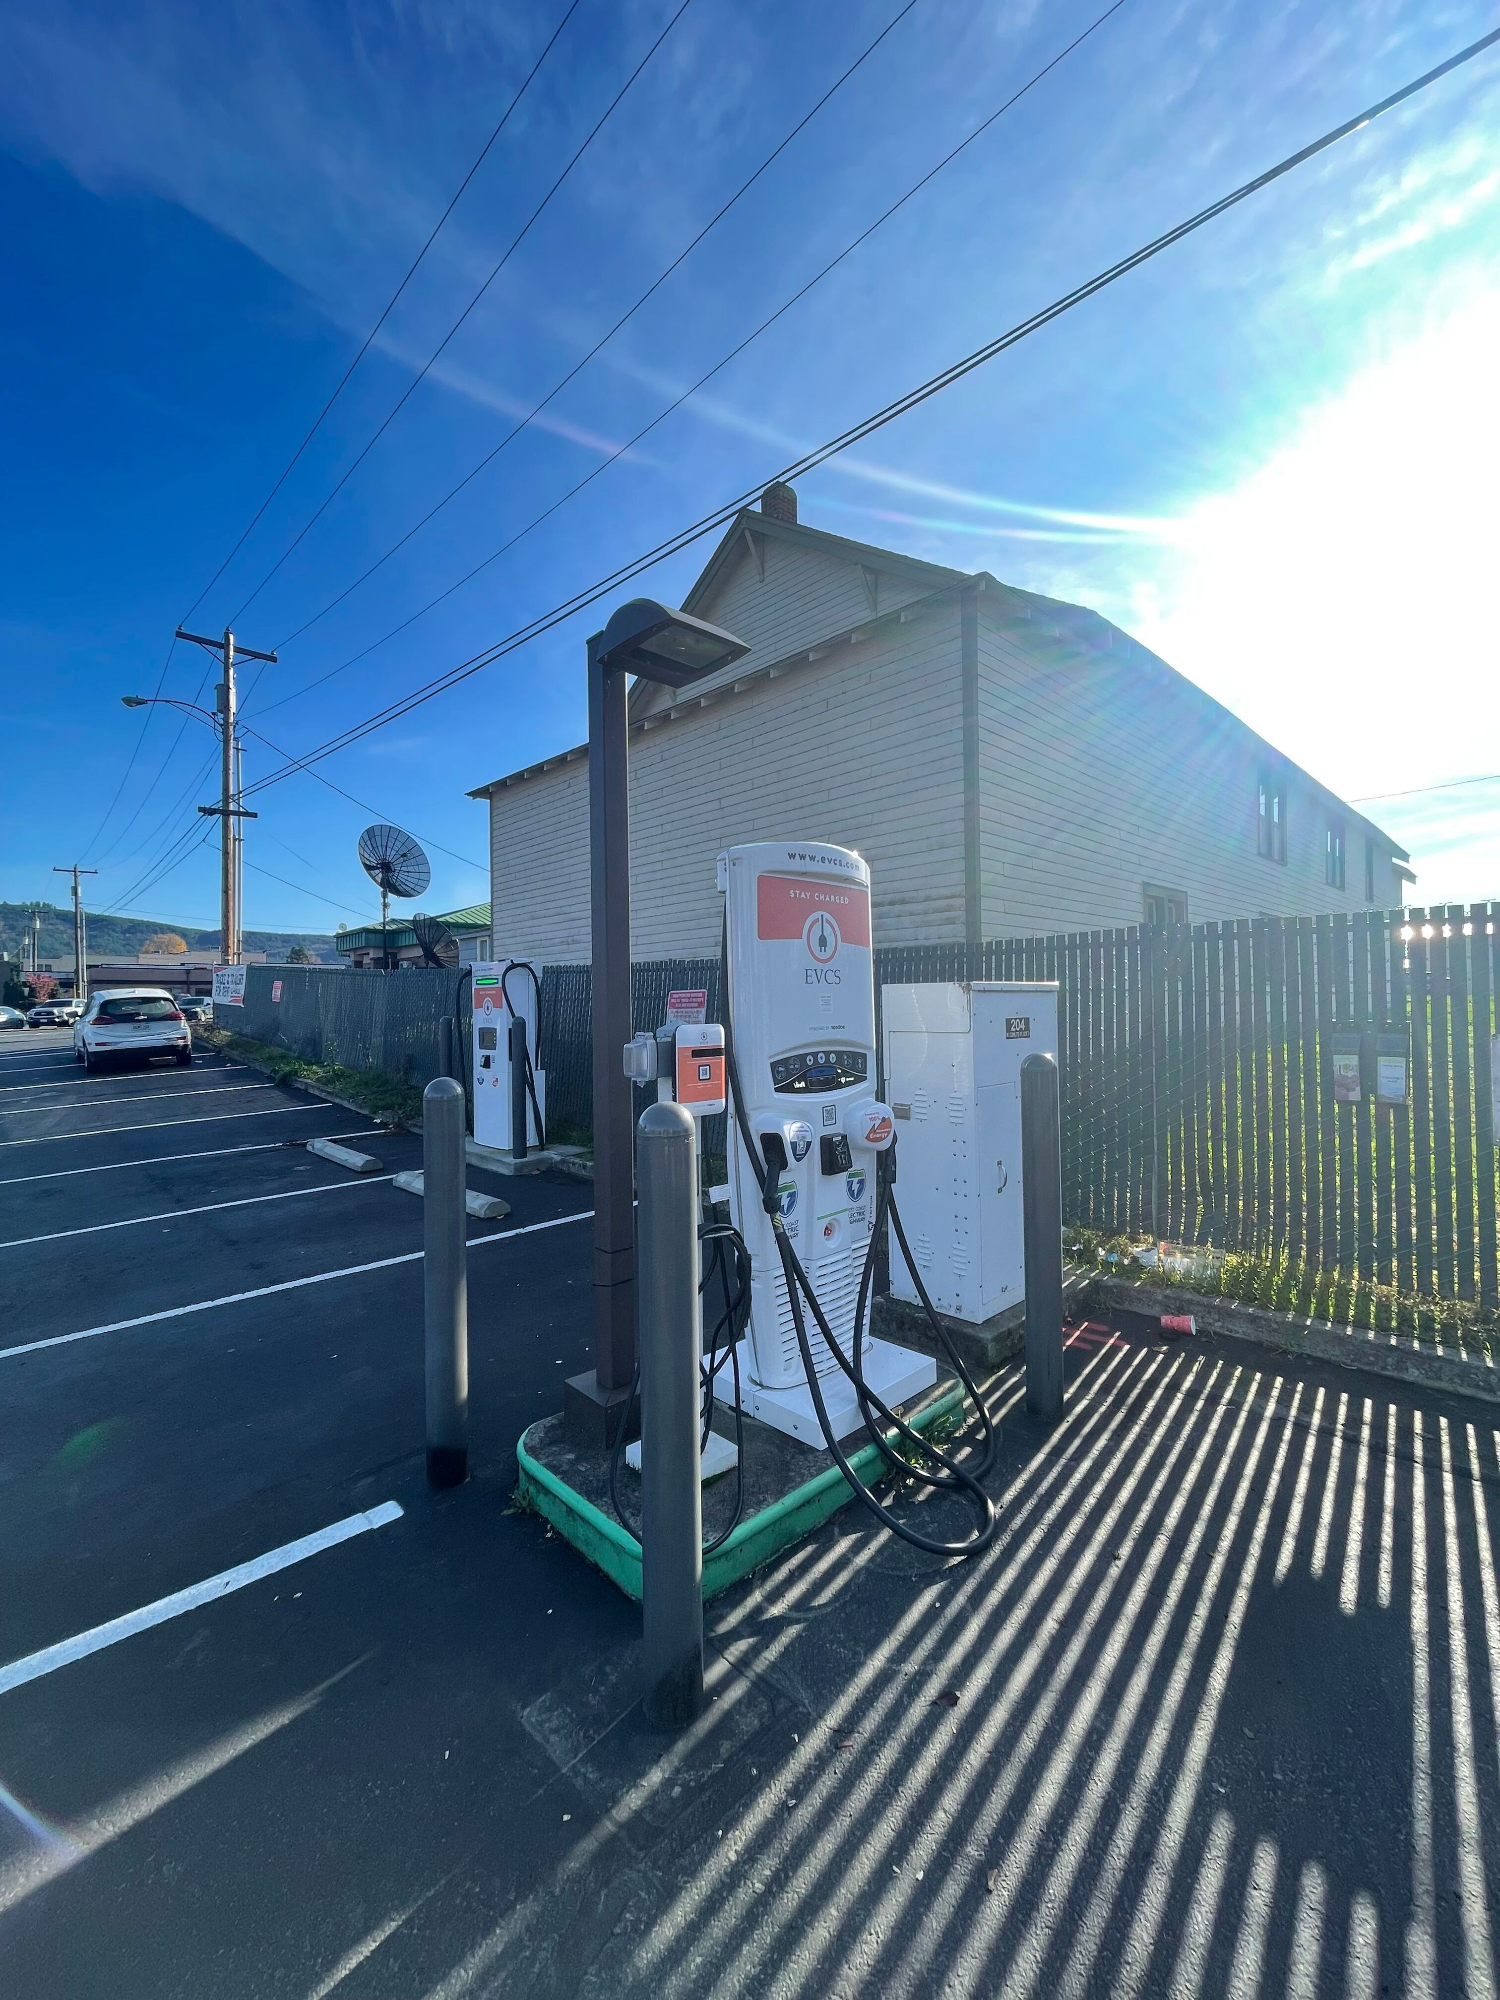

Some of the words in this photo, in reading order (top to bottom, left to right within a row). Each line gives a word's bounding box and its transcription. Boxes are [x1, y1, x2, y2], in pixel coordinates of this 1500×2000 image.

[789, 890, 811, 899] STAY
[814, 893, 849, 904] CHARGED
[804, 968, 841, 985] EVCS
[1010, 1018, 1025, 1031] 204
